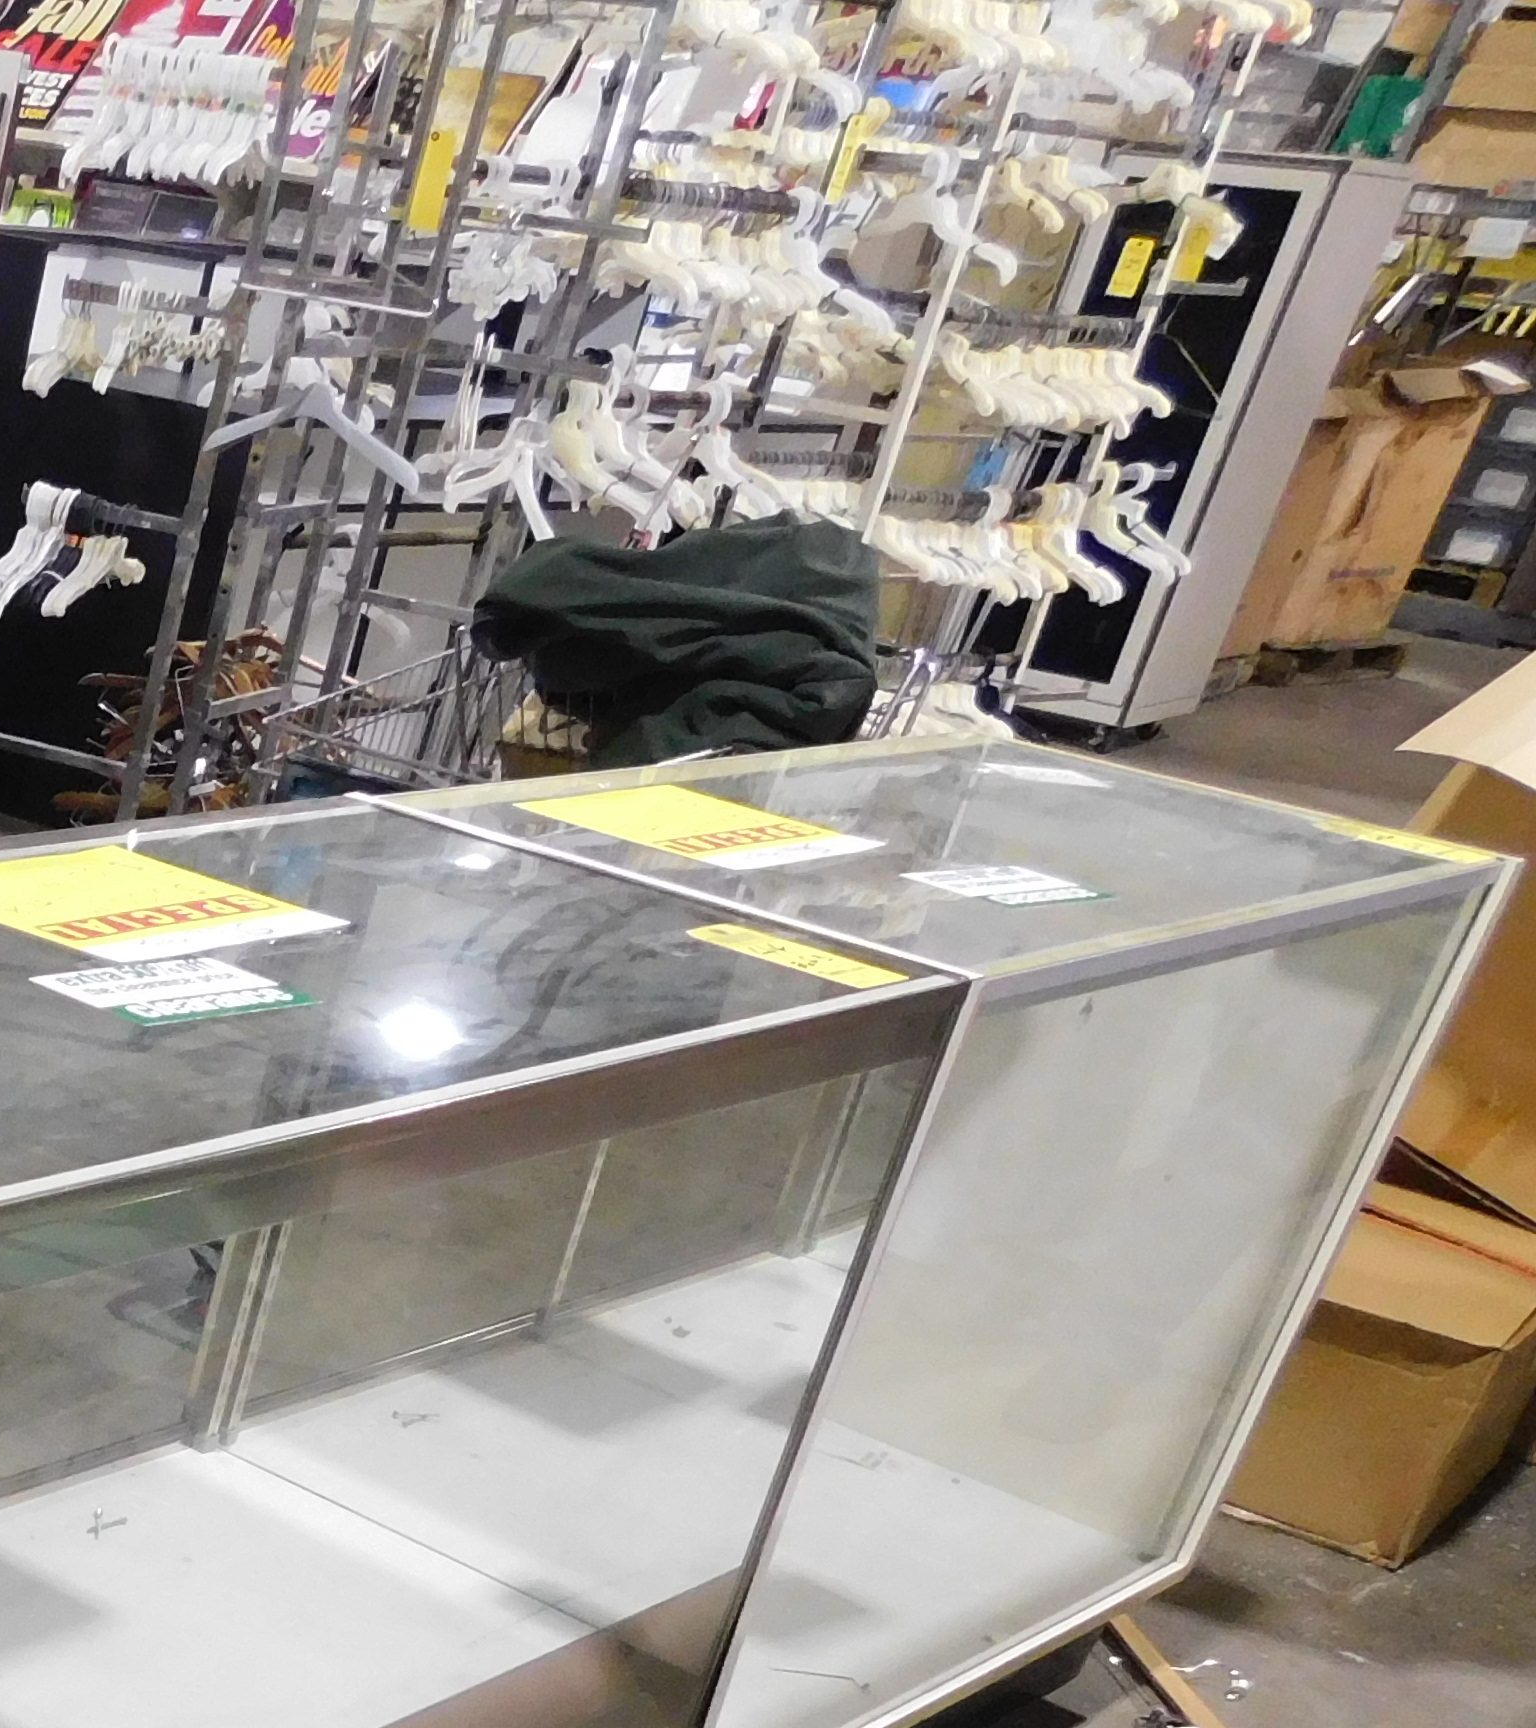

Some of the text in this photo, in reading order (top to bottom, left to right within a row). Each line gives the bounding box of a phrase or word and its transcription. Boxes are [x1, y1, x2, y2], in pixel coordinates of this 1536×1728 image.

[40, 895, 272, 940] SPECIAL
[55, 964, 125, 986] extra
[124, 987, 294, 1018] clearance
